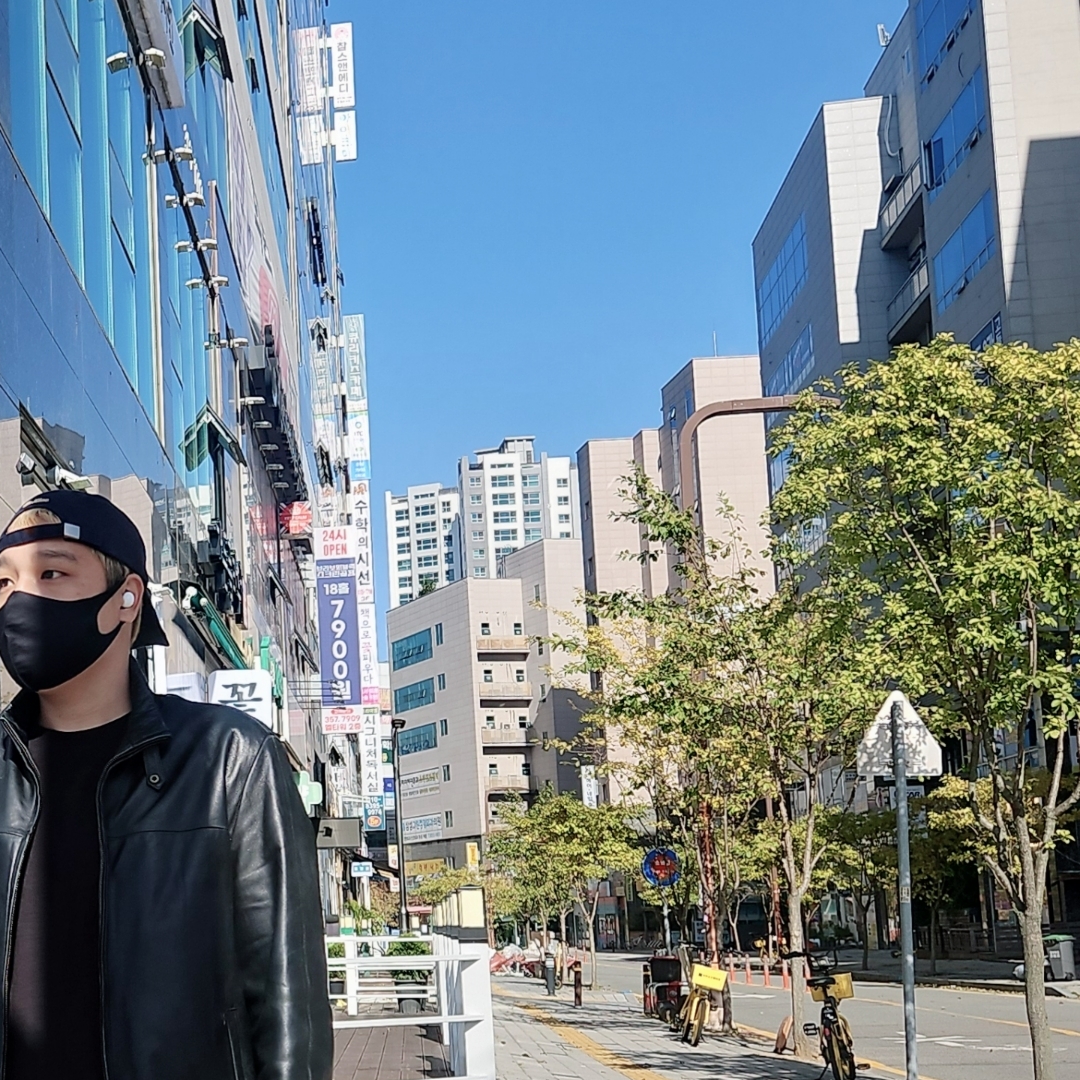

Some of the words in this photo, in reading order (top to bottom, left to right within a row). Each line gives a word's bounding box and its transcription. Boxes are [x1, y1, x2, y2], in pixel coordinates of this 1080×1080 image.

[322, 529, 348, 542] 24시
[323, 544, 348, 556] OPEN
[354, 500, 370, 586] 수학의시선
[323, 582, 350, 596] 18홀
[364, 715, 379, 793] 시그니처독서실
